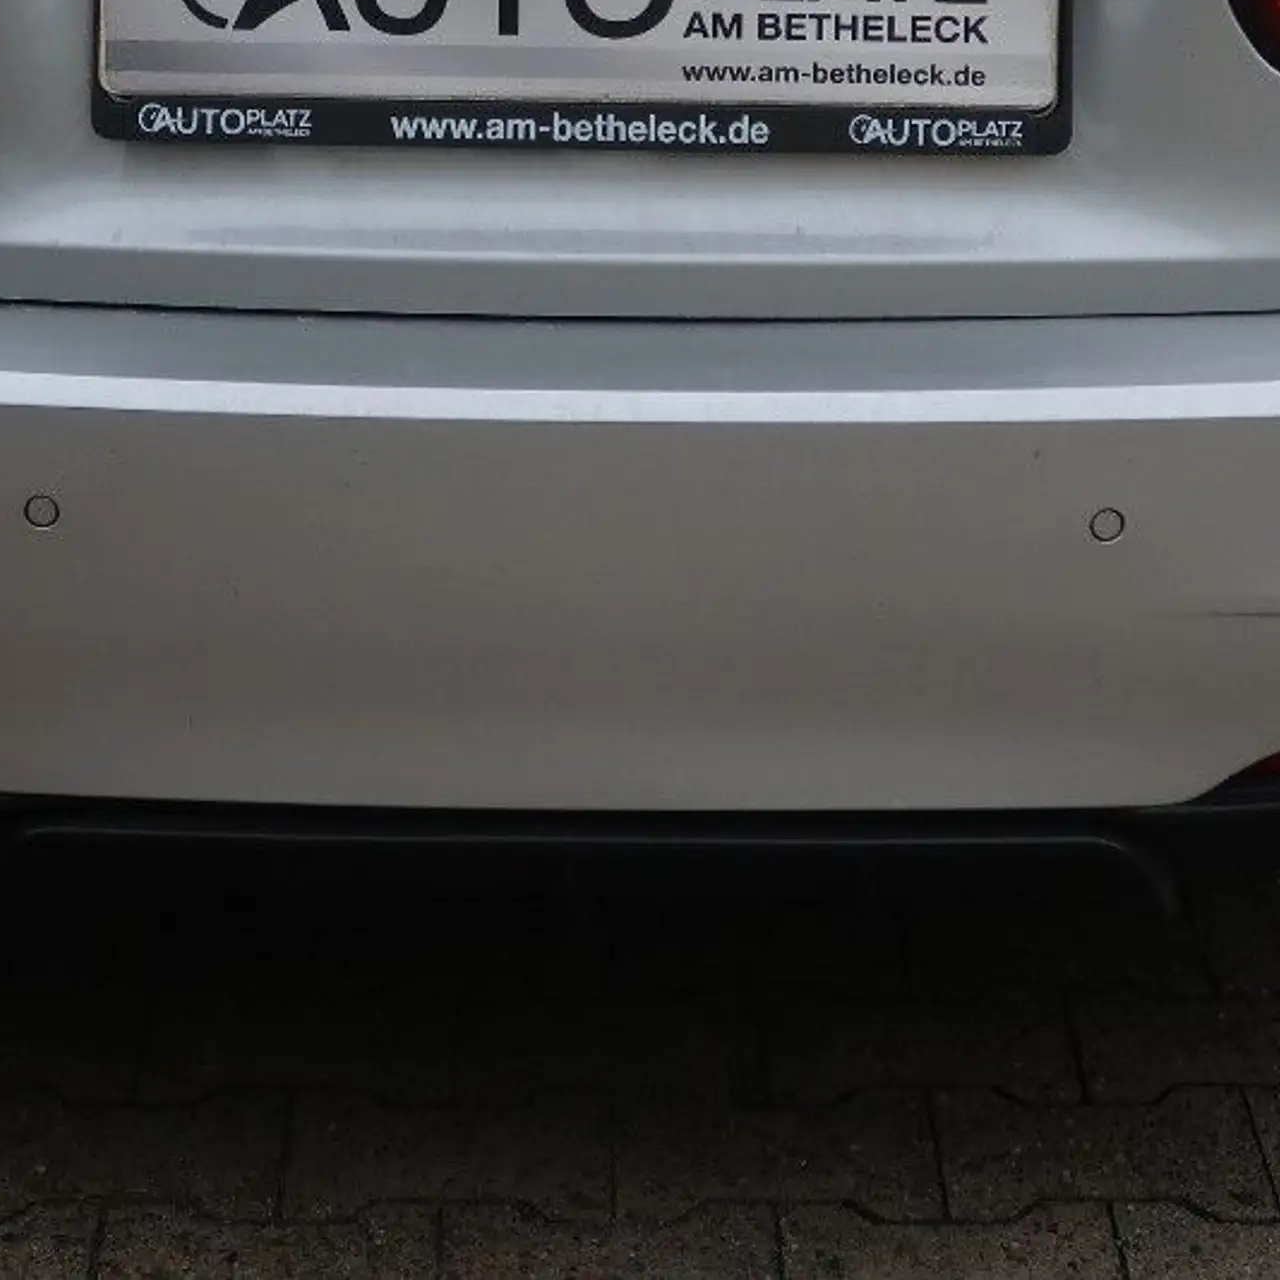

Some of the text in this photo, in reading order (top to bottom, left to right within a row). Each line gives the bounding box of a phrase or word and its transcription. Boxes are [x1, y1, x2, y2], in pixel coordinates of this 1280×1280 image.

[683, 11, 988, 44] AM BETHELECK
[681, 62, 986, 86] www.am-betheleck.de
[390, 112, 769, 145] www.am-betheleck.de
